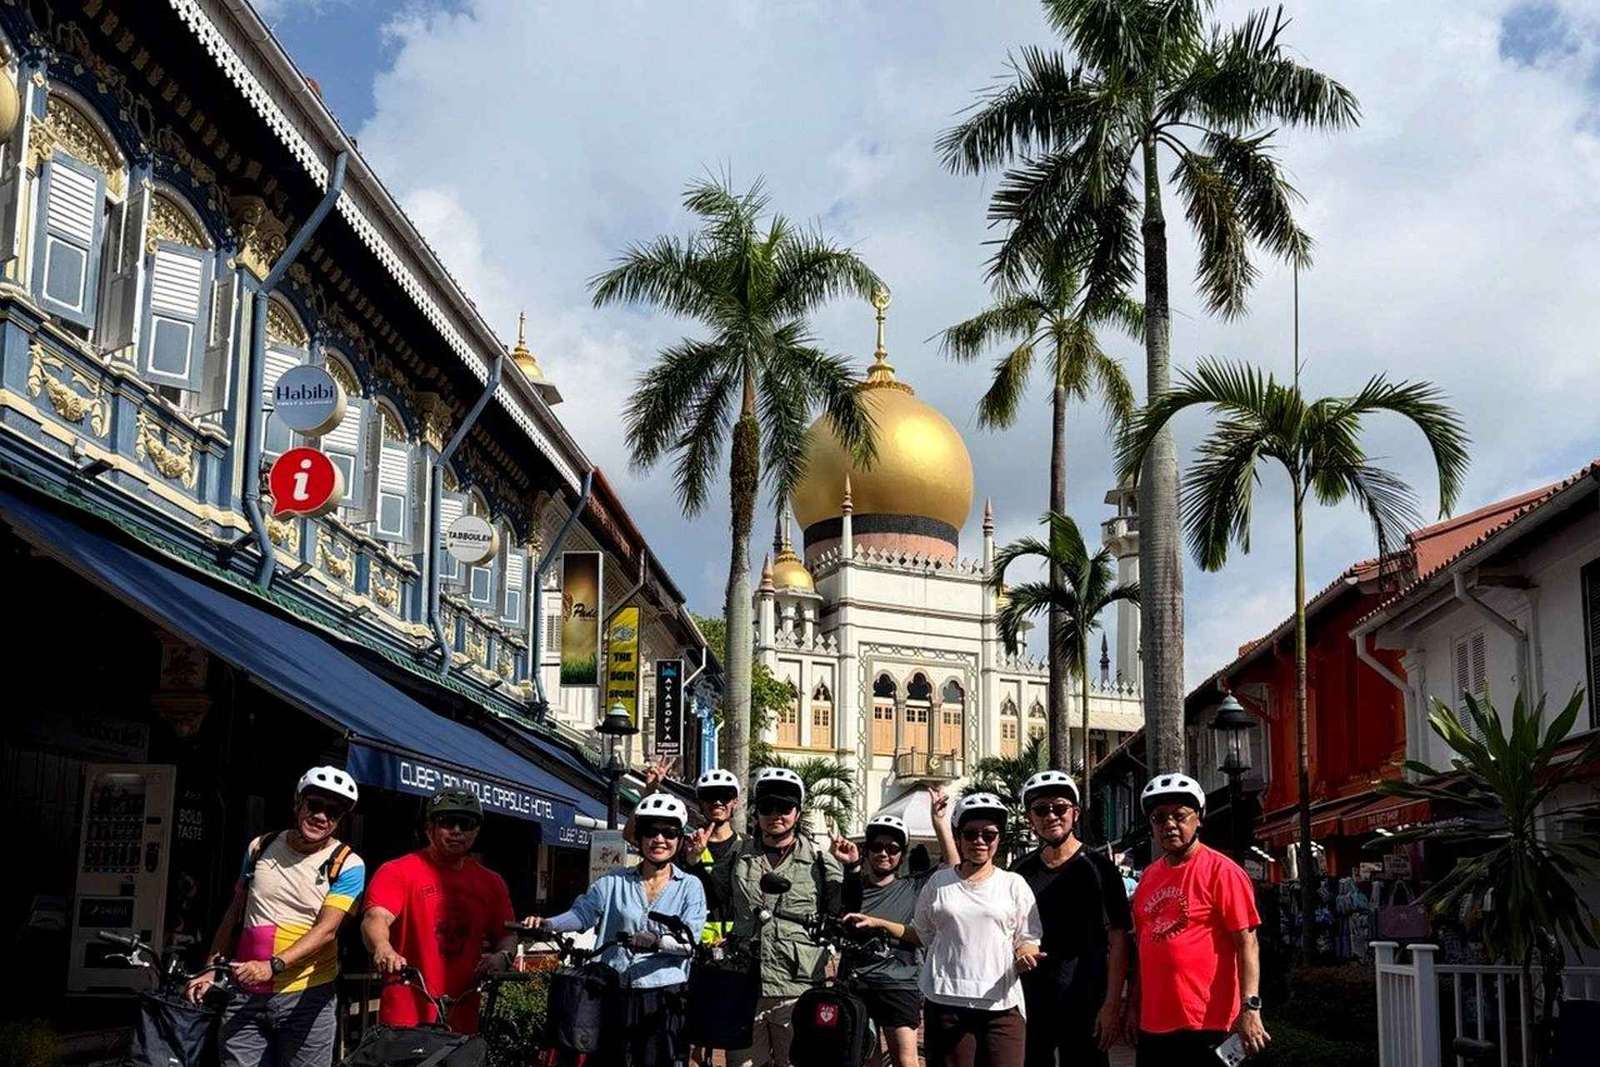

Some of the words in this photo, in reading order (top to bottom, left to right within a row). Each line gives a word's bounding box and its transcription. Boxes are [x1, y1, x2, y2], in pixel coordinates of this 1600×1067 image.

[277, 384, 333, 400] Habibi
[614, 652, 632, 662] THE
[664, 678, 673, 740] AYASOFYA
[492, 787, 530, 814] CAPSULE
[531, 797, 555, 820] HOTEL
